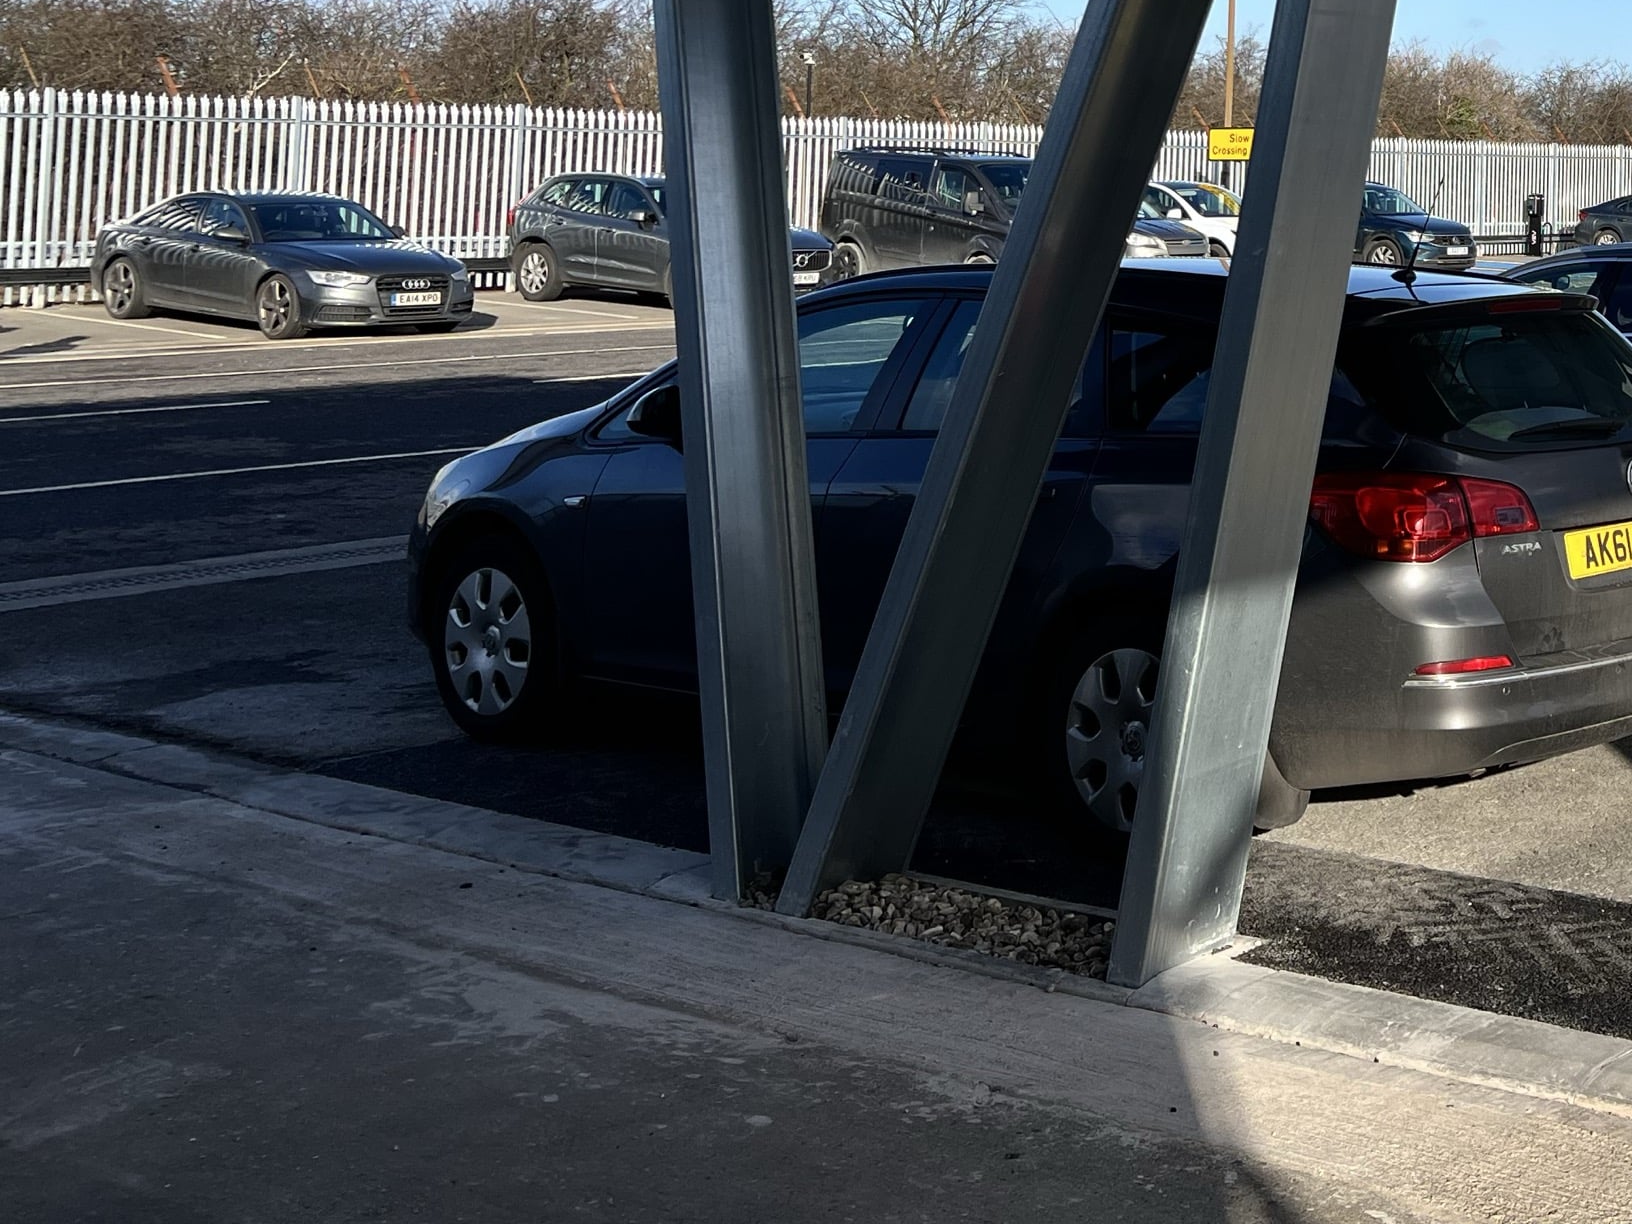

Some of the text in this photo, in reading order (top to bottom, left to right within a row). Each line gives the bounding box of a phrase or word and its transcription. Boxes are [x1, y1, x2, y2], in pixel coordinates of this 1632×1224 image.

[1229, 133, 1250, 143] Slow
[1212, 145, 1248, 156] Crossing
[399, 293, 420, 303] EA14
[1502, 541, 1542, 555] ASTRA
[1585, 526, 1632, 569] AK61
